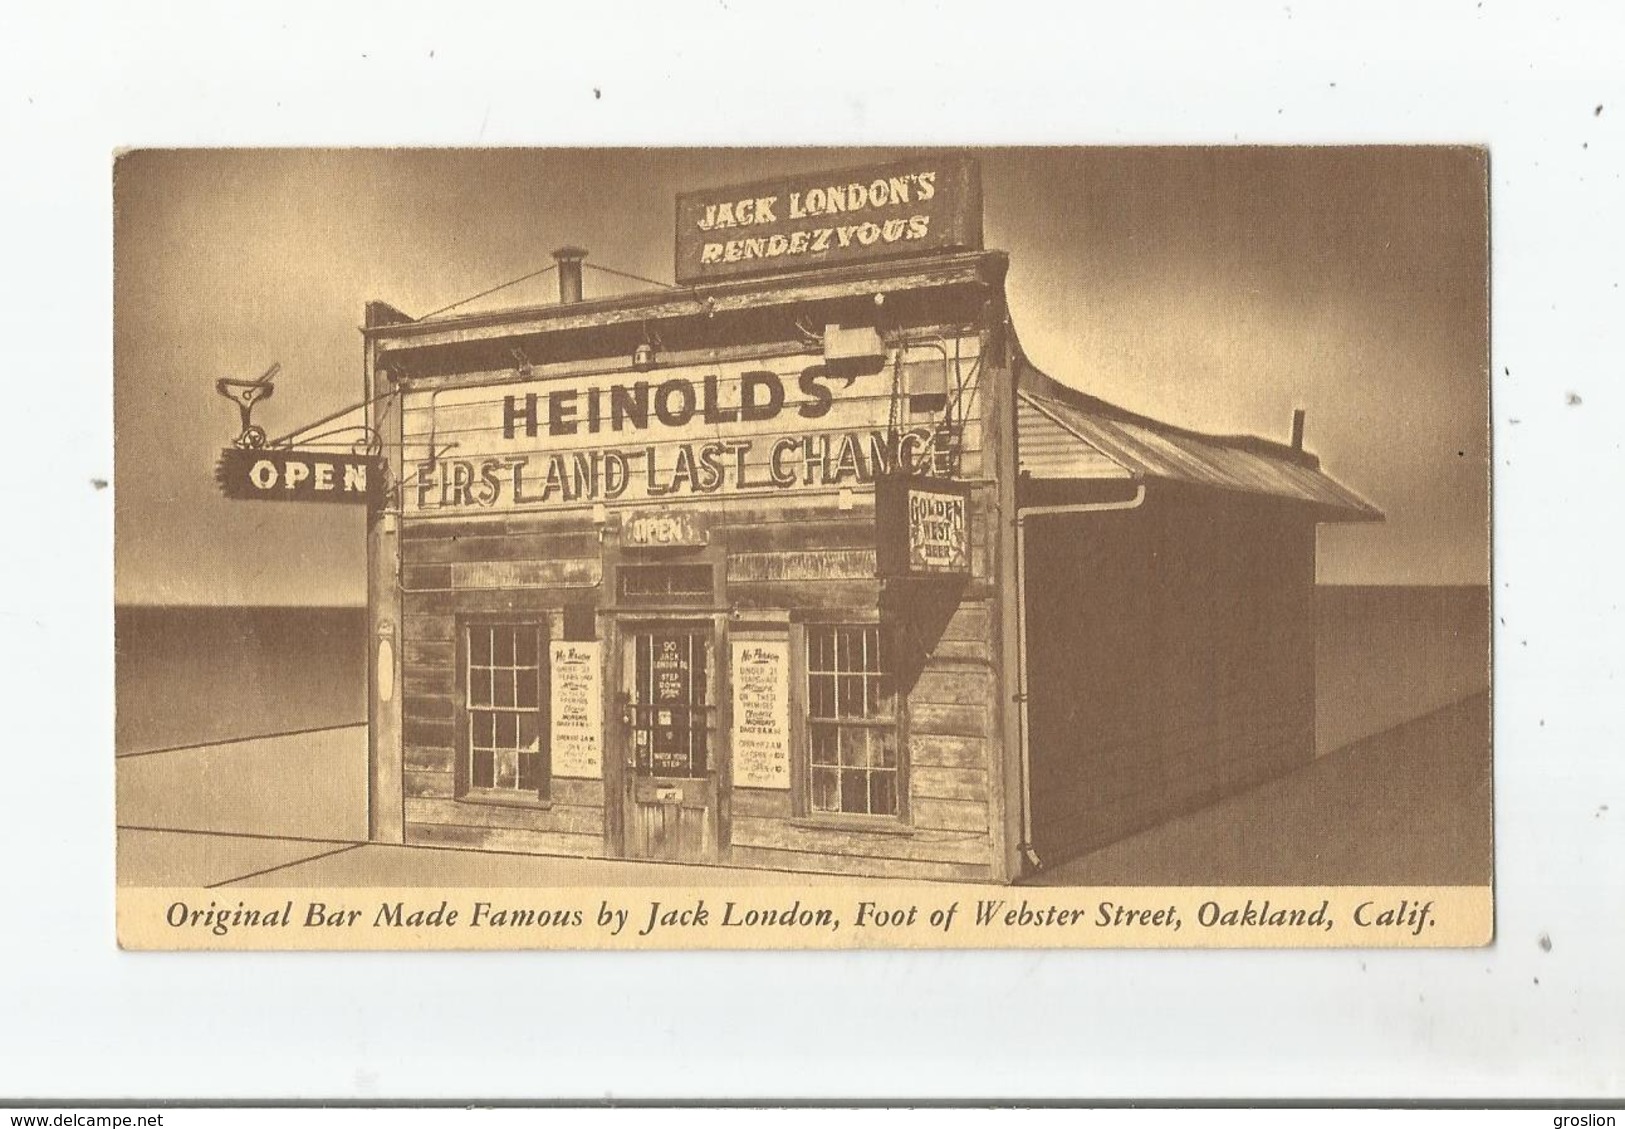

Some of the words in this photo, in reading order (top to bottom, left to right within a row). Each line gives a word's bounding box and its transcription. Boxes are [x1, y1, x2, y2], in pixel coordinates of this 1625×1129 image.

[697, 196, 777, 230] JACK
[789, 171, 936, 220] LONDON'S
[701, 215, 930, 264] RENDEZVOUS
[249, 459, 367, 492] OPEN
[416, 455, 540, 511] FIRST
[543, 449, 630, 503] AND
[645, 436, 754, 496] LAST
[769, 424, 962, 488] CHANCE
[911, 496, 963, 531] GOLDEN
[632, 517, 683, 543] OPEN
[922, 520, 951, 541] WEST
[925, 544, 951, 558] BEER
[660, 652, 679, 661] JACK
[663, 641, 677, 652] 90
[741, 649, 753, 662] No
[661, 673, 679, 681] STEP
